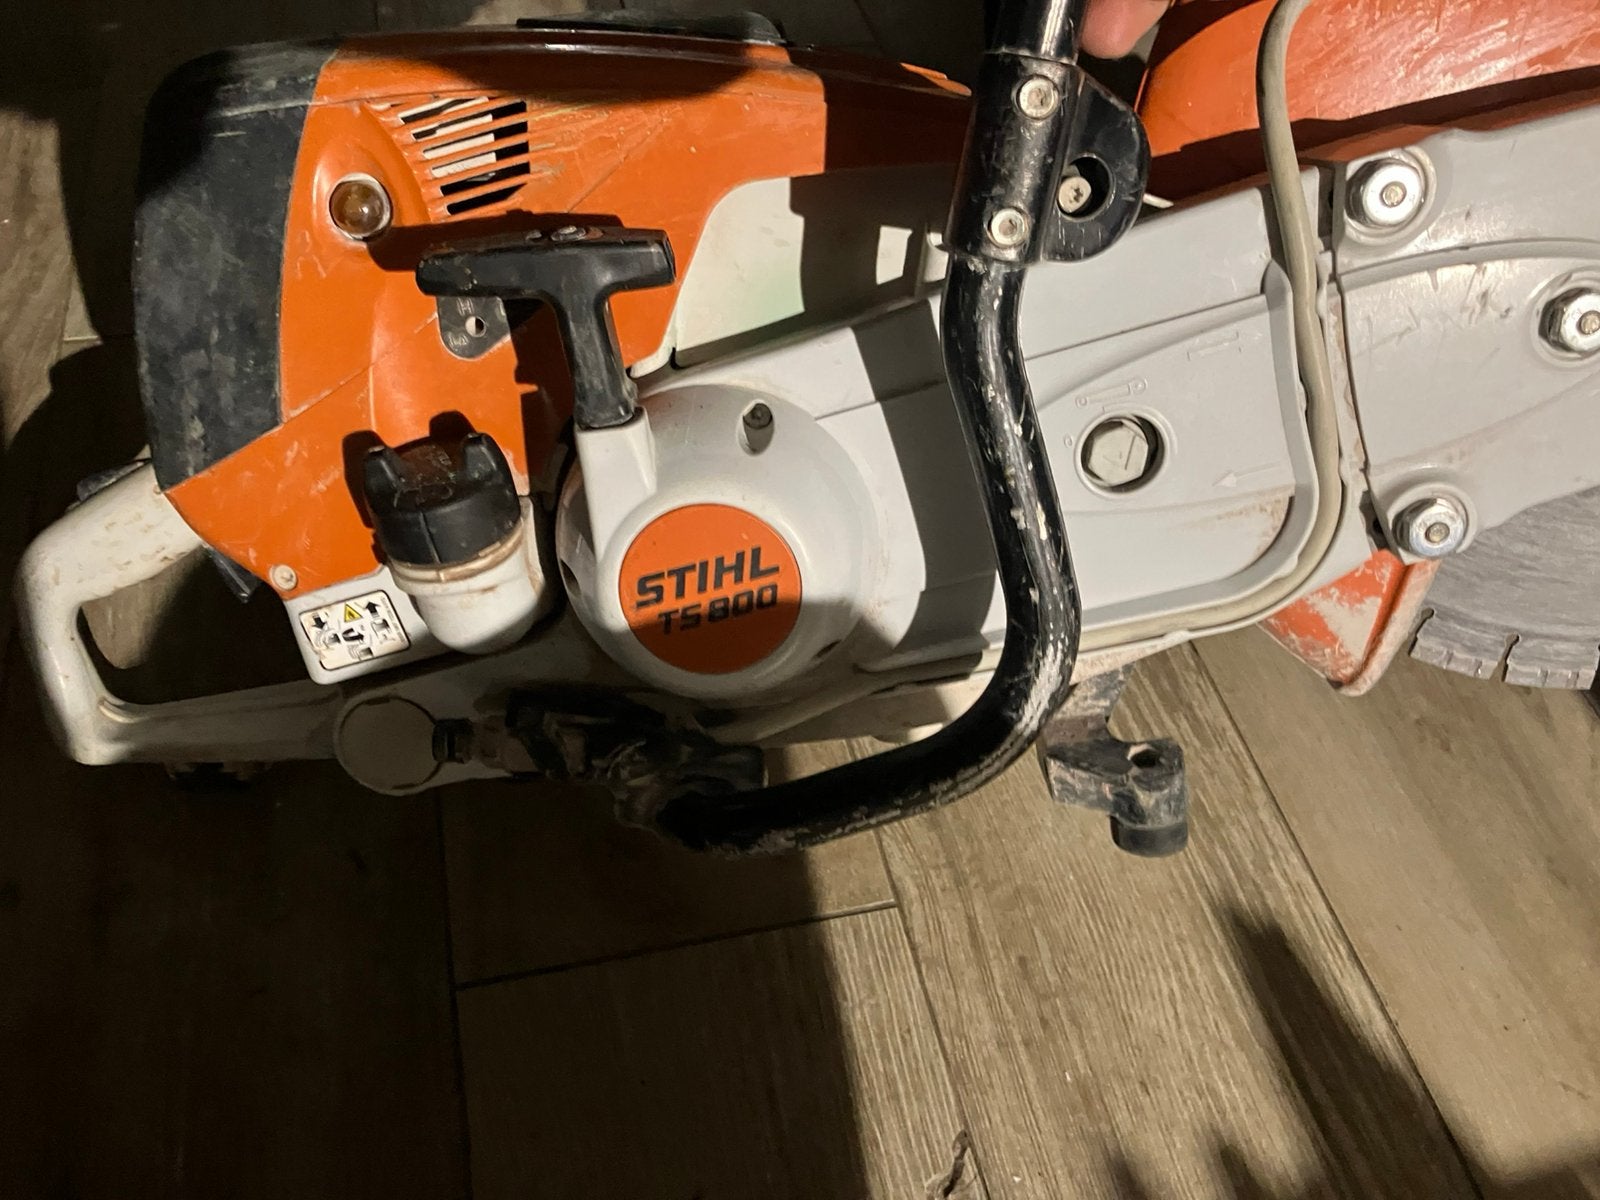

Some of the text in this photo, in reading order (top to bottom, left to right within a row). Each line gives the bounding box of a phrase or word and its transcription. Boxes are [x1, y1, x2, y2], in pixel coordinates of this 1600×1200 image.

[635, 546, 780, 609] STIHL
[657, 584, 778, 636] TS 800
